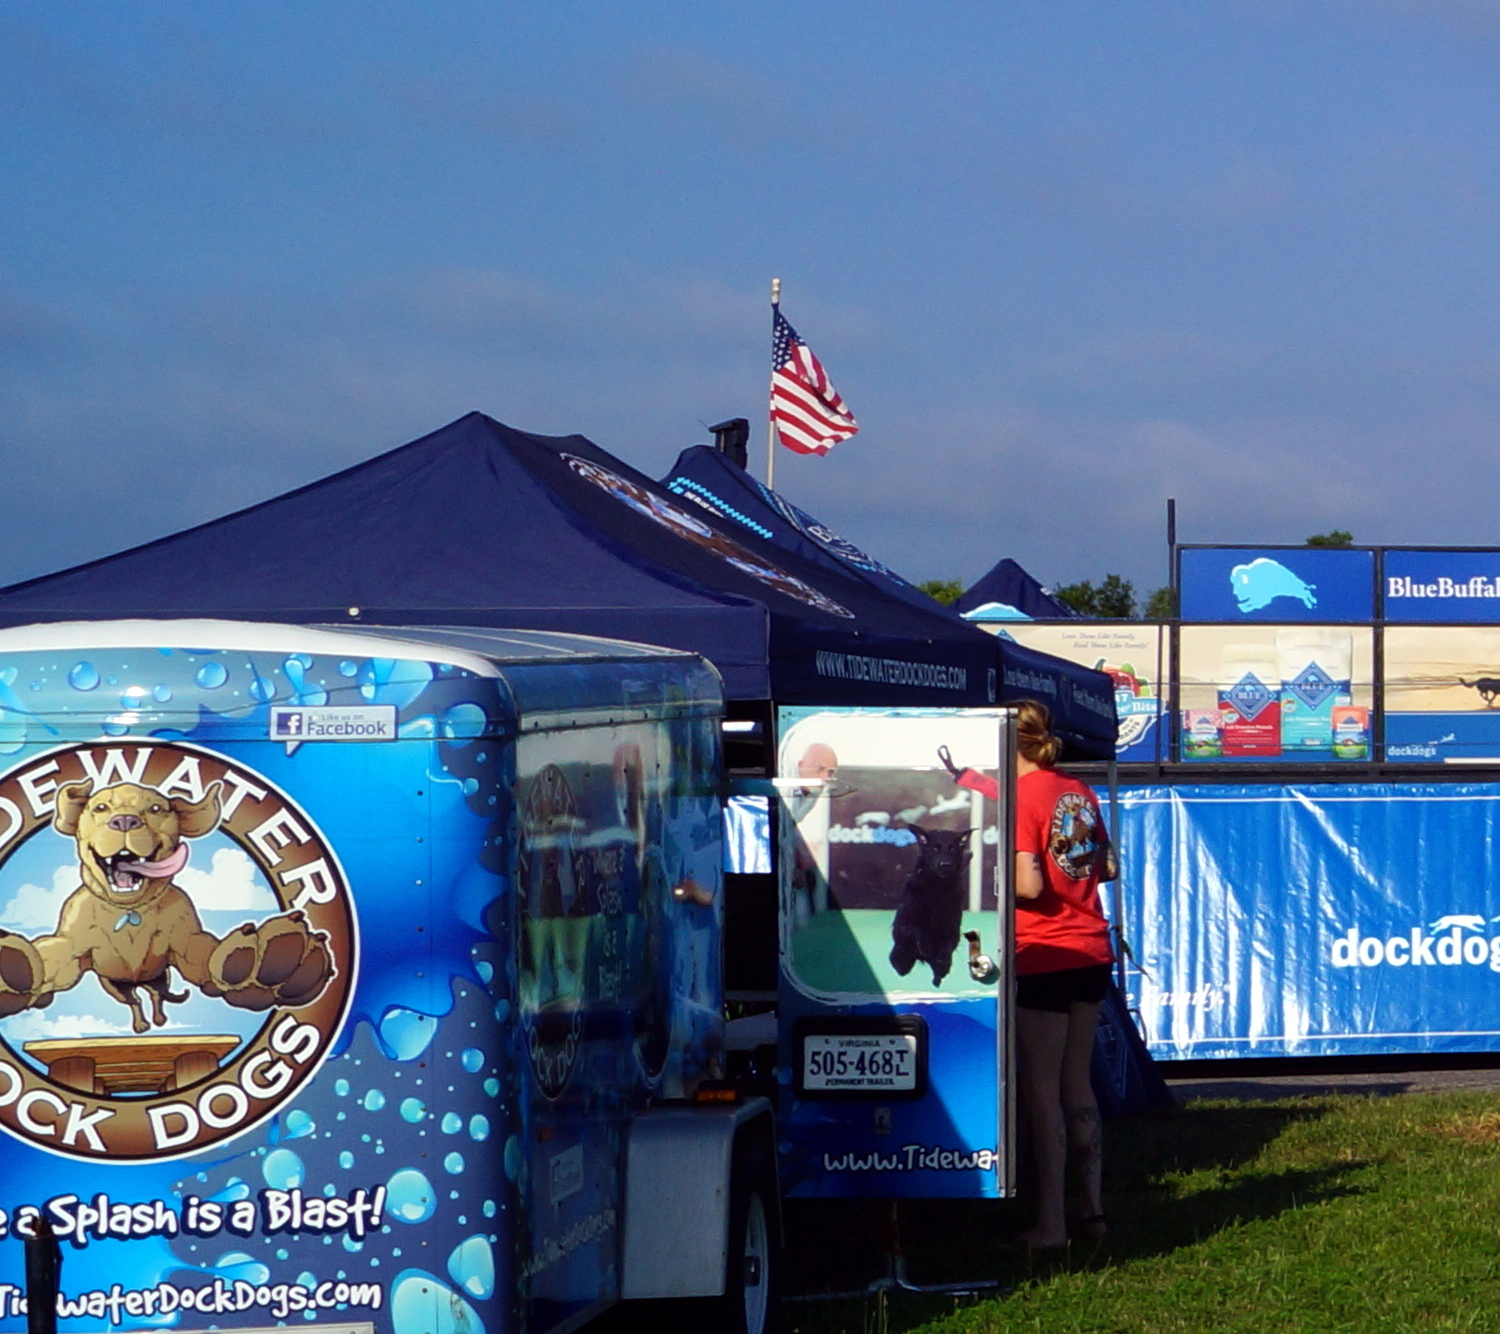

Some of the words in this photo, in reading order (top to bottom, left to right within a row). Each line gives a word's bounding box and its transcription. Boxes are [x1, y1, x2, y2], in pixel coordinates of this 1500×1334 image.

[815, 649, 967, 691] WWW.TIDEWATERDOCKDOGS.COM
[307, 720, 387, 736] Facebook
[1388, 744, 1437, 758] dockdogs
[839, 1040, 880, 1048] VIRGINIA
[148, 1016, 321, 1151] DOGS
[866, 1078, 895, 1086] TRAILER
[18, 1207, 40, 1236] a
[49, 1195, 177, 1244] Splash
[188, 1197, 222, 1232] is
[231, 1201, 256, 1232] a
[265, 1187, 386, 1236] Blast!
[0, 1281, 381, 1325] TiwaterDockDogs.com
